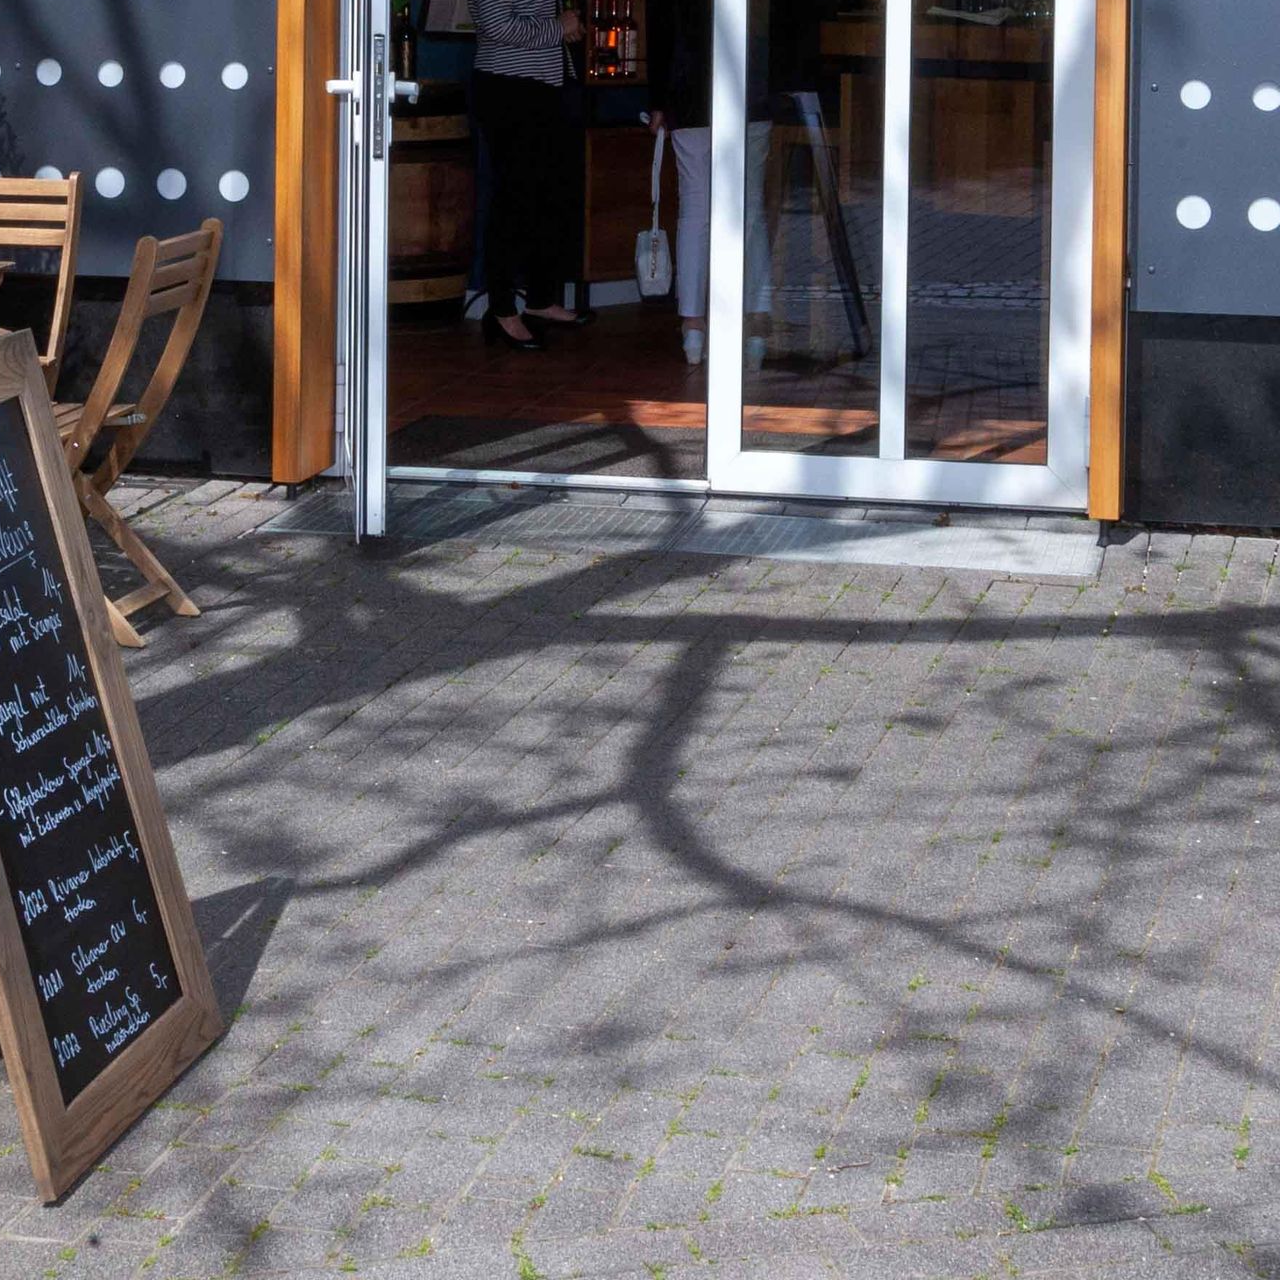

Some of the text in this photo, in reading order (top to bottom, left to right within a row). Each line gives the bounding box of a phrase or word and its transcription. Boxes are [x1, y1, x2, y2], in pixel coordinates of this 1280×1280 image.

[10, 622, 29, 653] mit
[30, 675, 50, 709] mit
[11, 705, 68, 753] Schwarzwälder
[63, 742, 96, 784] Spargel
[19, 823, 35, 848] mit
[19, 889, 48, 926] 2022
[48, 871, 90, 902] Rivaner
[64, 894, 97, 923] trocken
[39, 969, 64, 1001] 2021
[72, 945, 109, 975] Silvaner
[87, 965, 119, 993] trocken
[53, 1033, 81, 1068] 2022
[89, 1001, 130, 1040] Riesling
